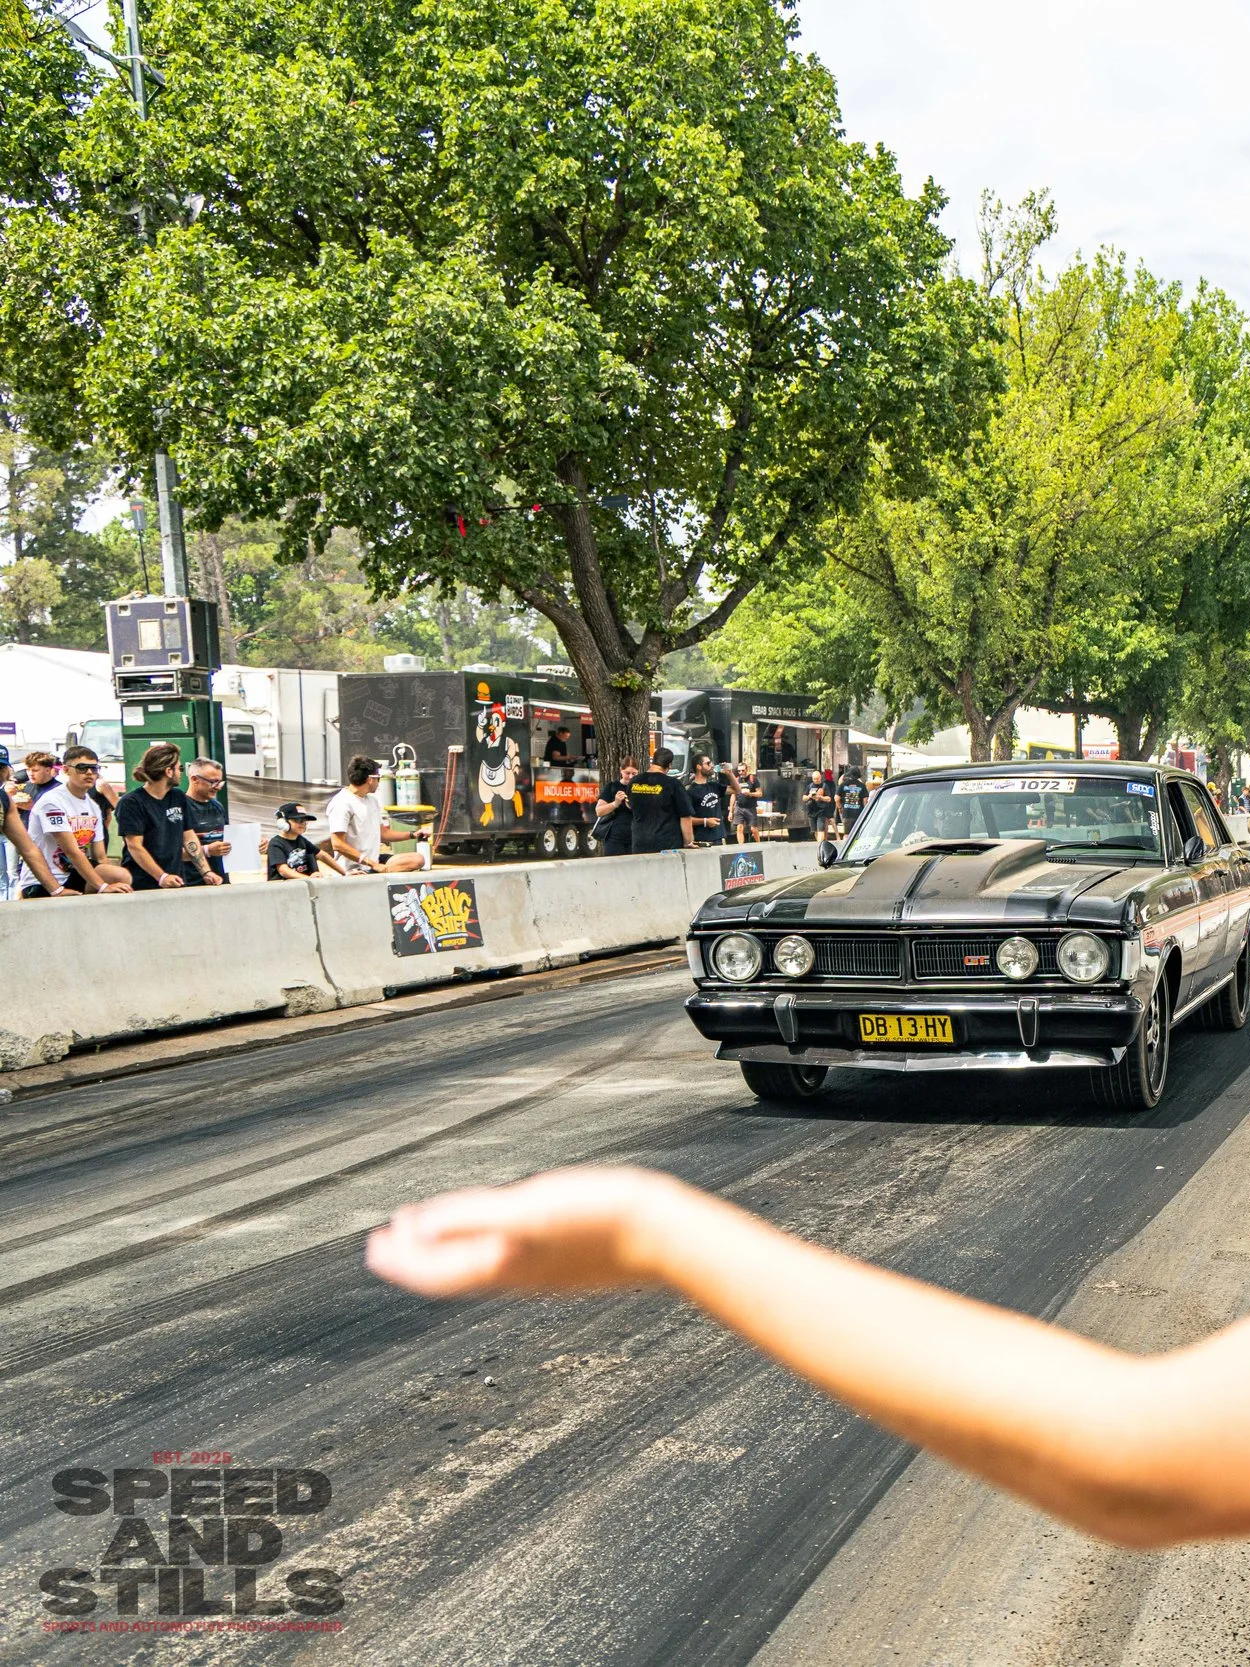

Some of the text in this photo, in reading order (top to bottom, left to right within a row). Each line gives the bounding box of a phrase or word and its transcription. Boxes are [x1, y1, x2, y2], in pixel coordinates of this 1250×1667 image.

[752, 705, 767, 715] KEBAB
[768, 706, 782, 717] SNACK
[783, 707, 796, 717] PACKS
[544, 785, 572, 797] INDULGE
[574, 786, 581, 797] IN
[582, 786, 593, 798] THE
[1020, 781, 1060, 790] 1072
[49, 816, 63, 825] 38
[421, 887, 472, 921] BANG
[432, 914, 469, 937] SHIFT
